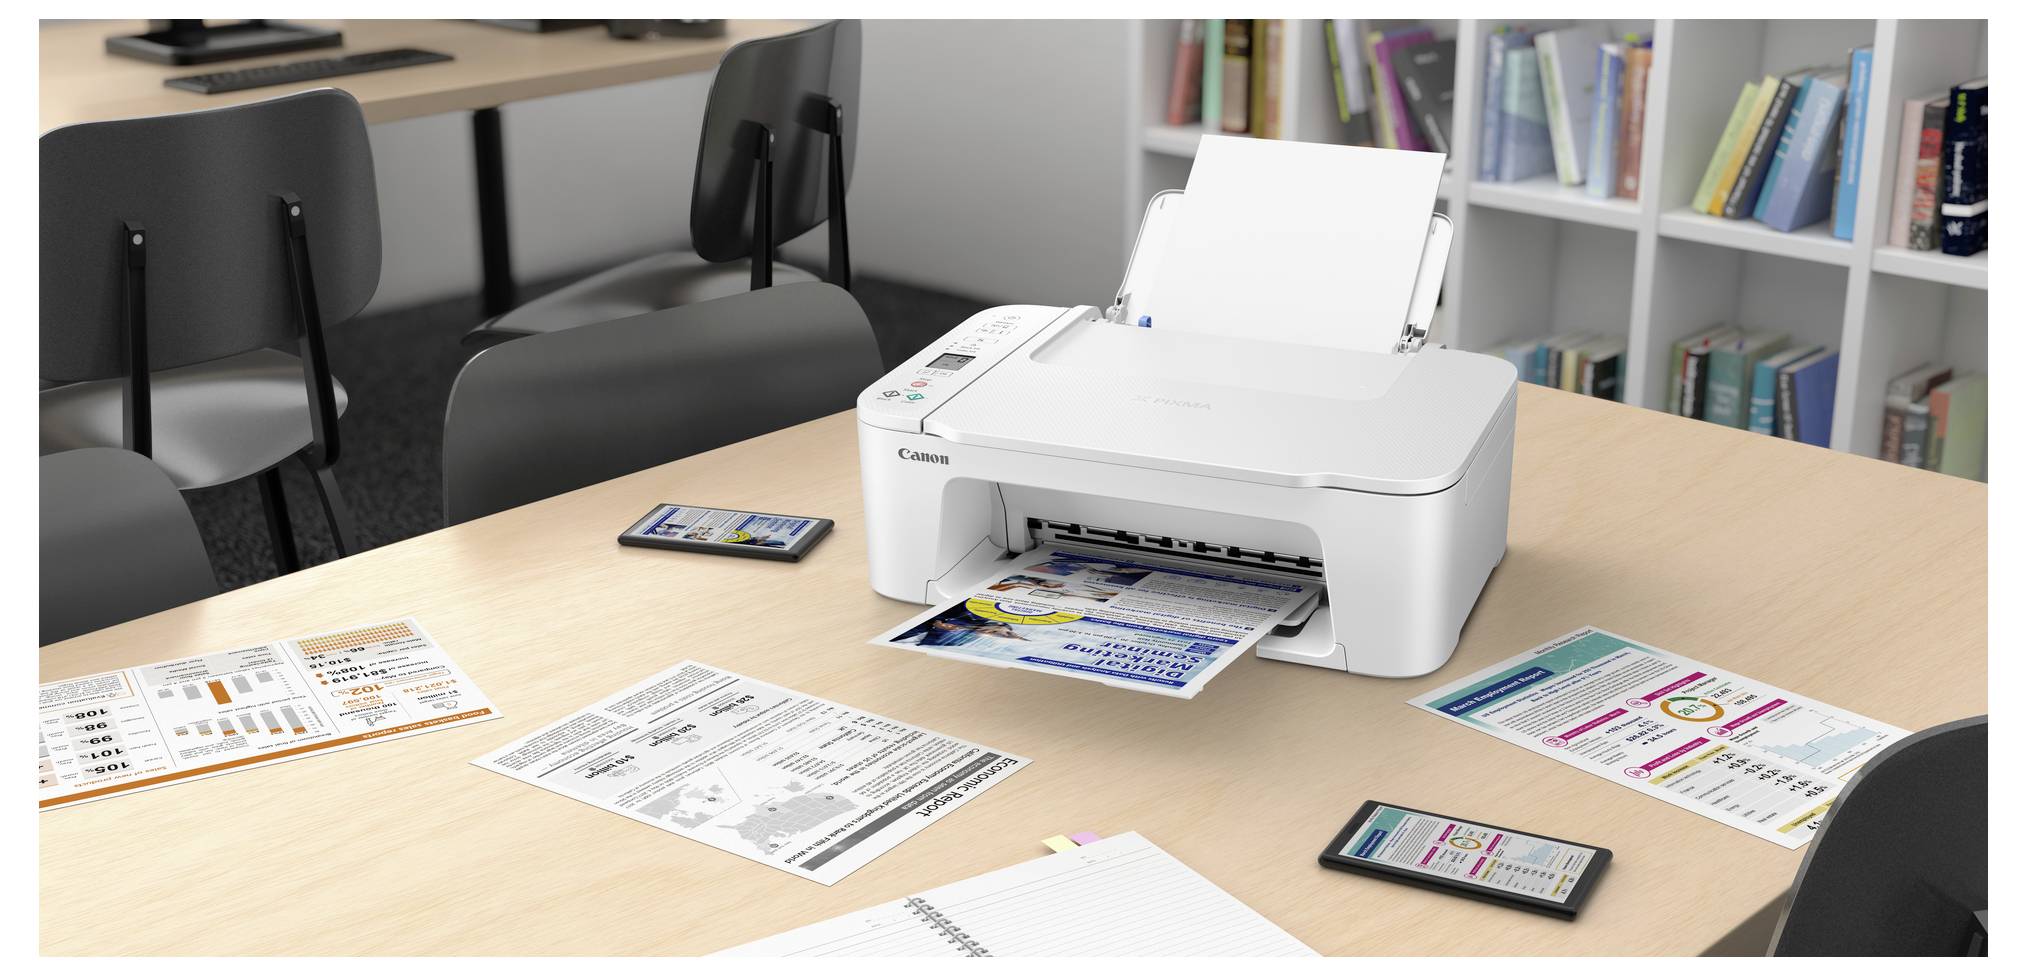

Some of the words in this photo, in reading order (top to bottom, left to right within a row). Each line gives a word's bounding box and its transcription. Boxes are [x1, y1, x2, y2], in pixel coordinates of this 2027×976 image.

[898, 448, 949, 465] Canon
[1063, 643, 1194, 671] Marketing
[1100, 642, 1203, 663] Seminar
[326, 665, 366, 676] 108%
[1094, 659, 1184, 679] Digital
[338, 684, 384, 696] 102%
[1449, 700, 1477, 712] March
[1473, 680, 1522, 702] Employment
[1518, 670, 1546, 683] Report
[66, 709, 108, 719] 108%
[709, 702, 739, 717] billion
[1677, 704, 1706, 716] 20.7%
[75, 722, 107, 731] 98%
[80, 735, 112, 745] 99%
[648, 732, 680, 747] billion
[79, 748, 123, 760] 101%
[951, 748, 980, 764] California
[1712, 753, 1736, 764] +1.2%
[85, 762, 130, 774] 105%
[585, 763, 618, 779] billion
[925, 763, 955, 780] Economy
[956, 757, 1019, 792] Economic
[902, 778, 929, 794] Exceeds
[882, 792, 905, 806] United
[915, 791, 964, 817] Report
[827, 827, 847, 838] Rank
[812, 836, 831, 847] Fifth
[784, 850, 809, 864] World
